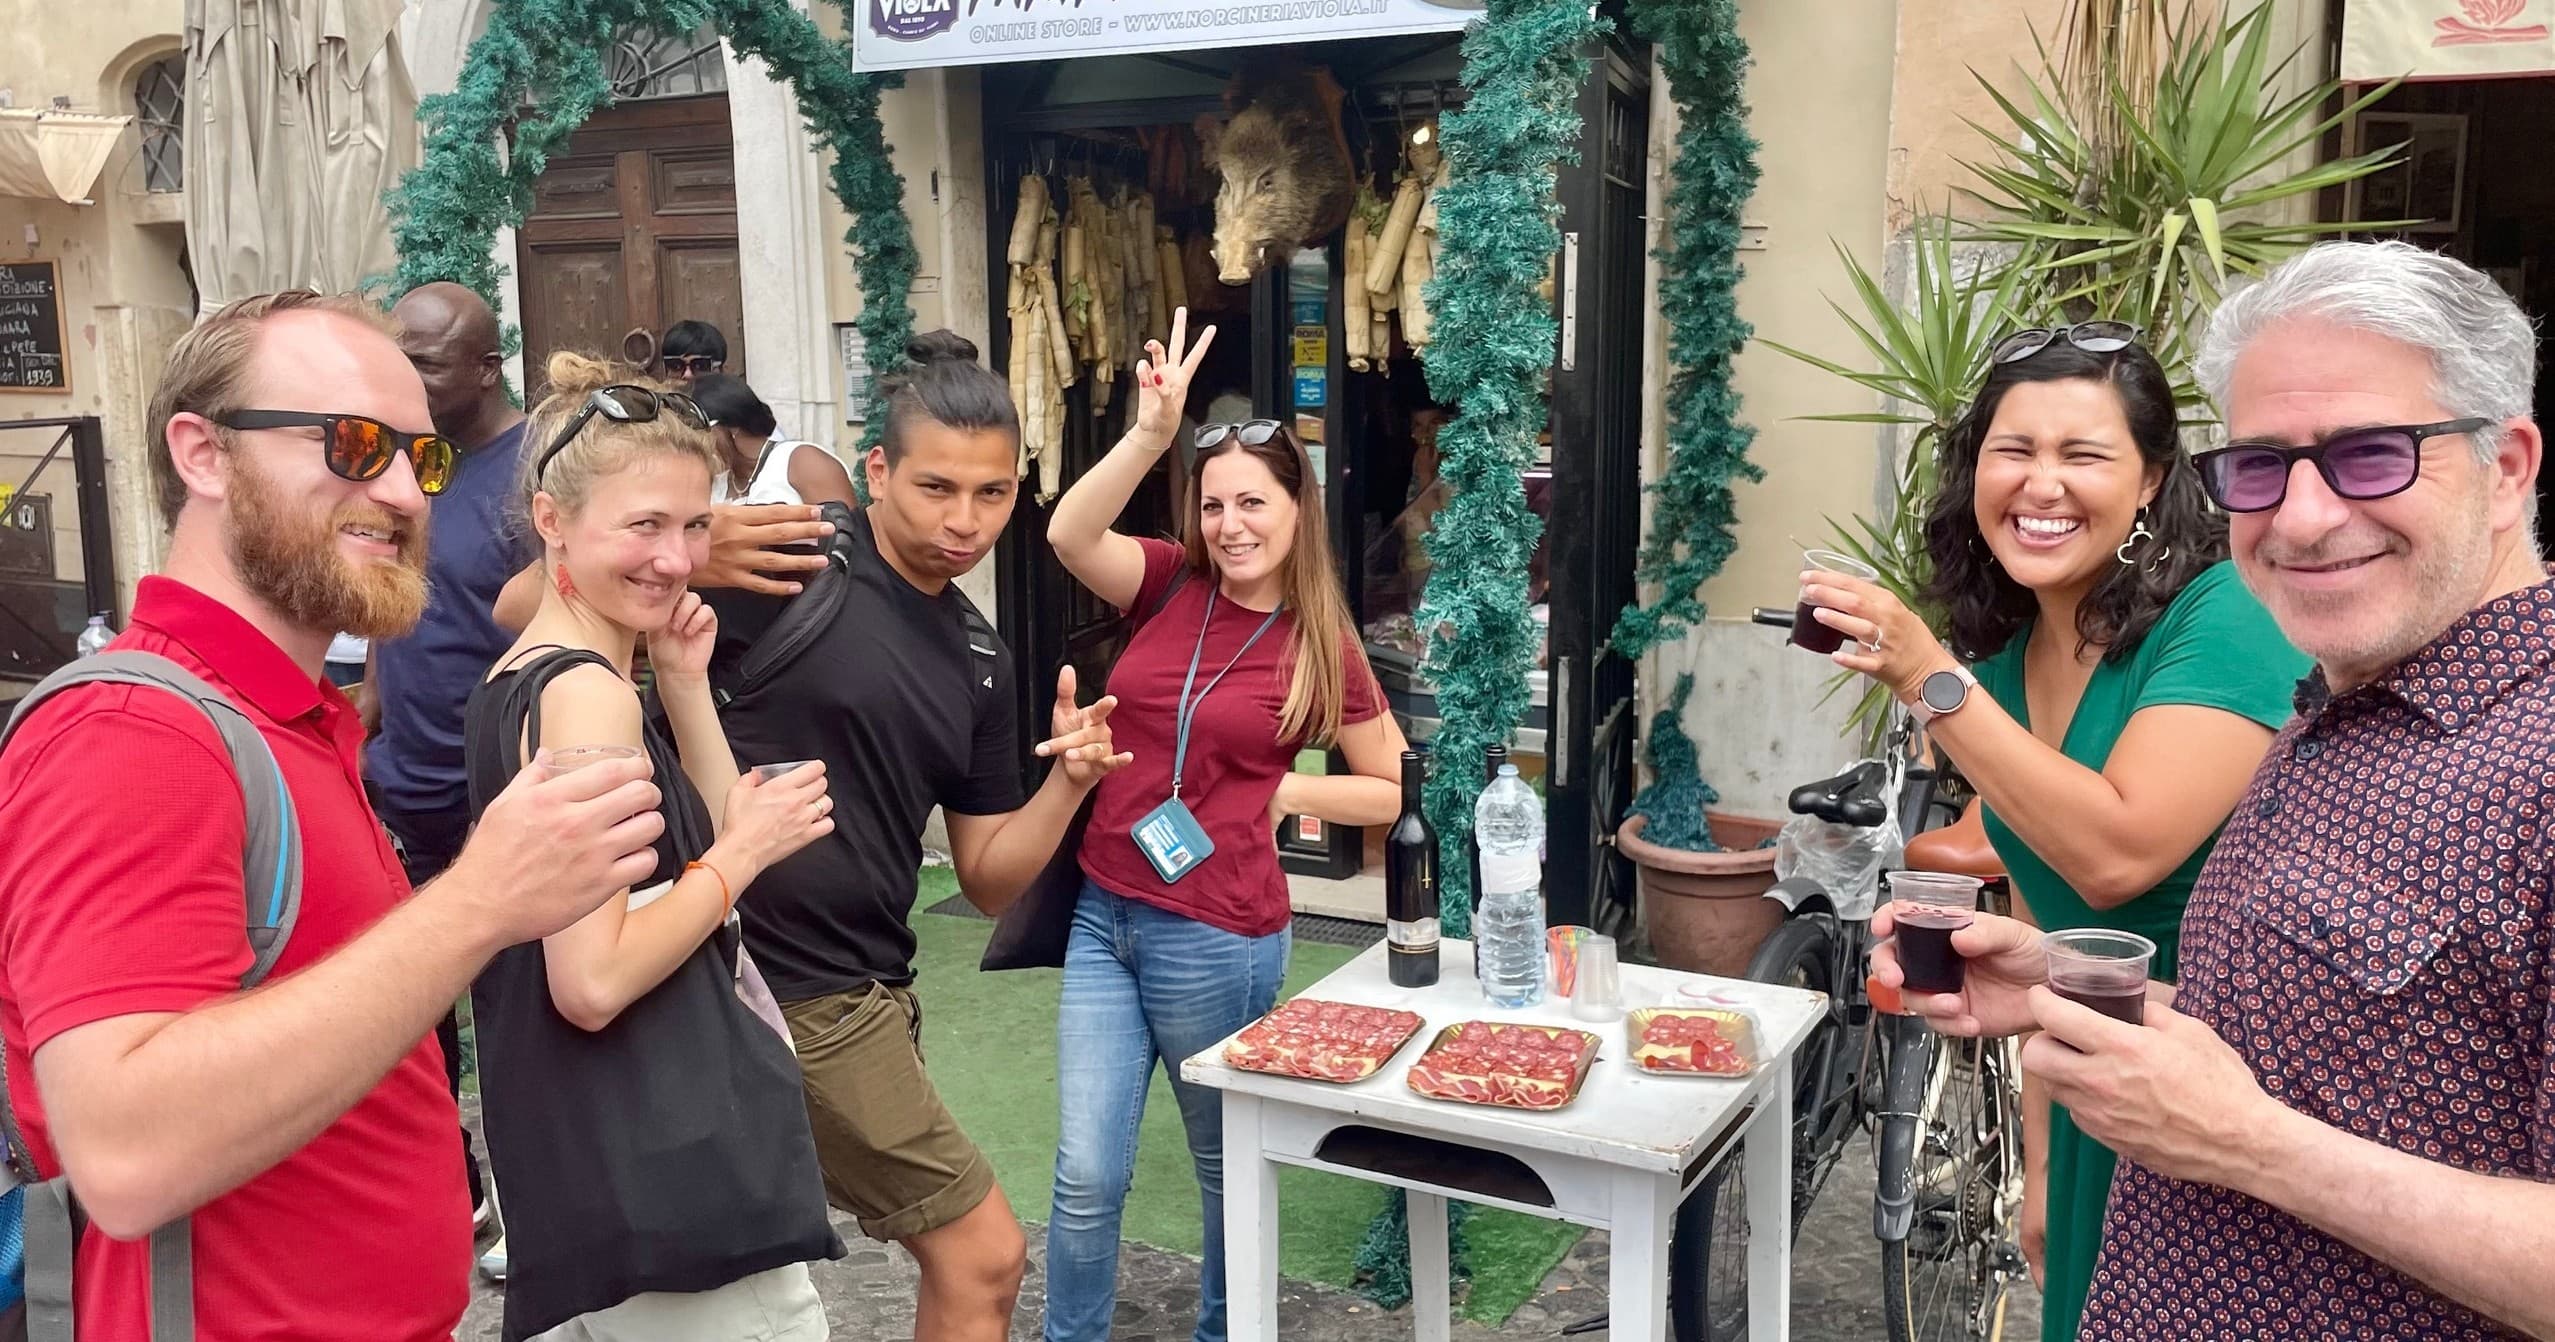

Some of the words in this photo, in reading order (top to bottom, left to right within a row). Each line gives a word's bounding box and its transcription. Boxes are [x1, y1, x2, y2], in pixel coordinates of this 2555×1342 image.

[879, 0, 951, 22] VIOLA
[970, 22, 1036, 44] ONLINE
[1041, 17, 1102, 39] STORE
[1124, 0, 1389, 33] WWW.NORCINERIAVIOLA.IT
[0, 281, 46, 294] DIZIONE
